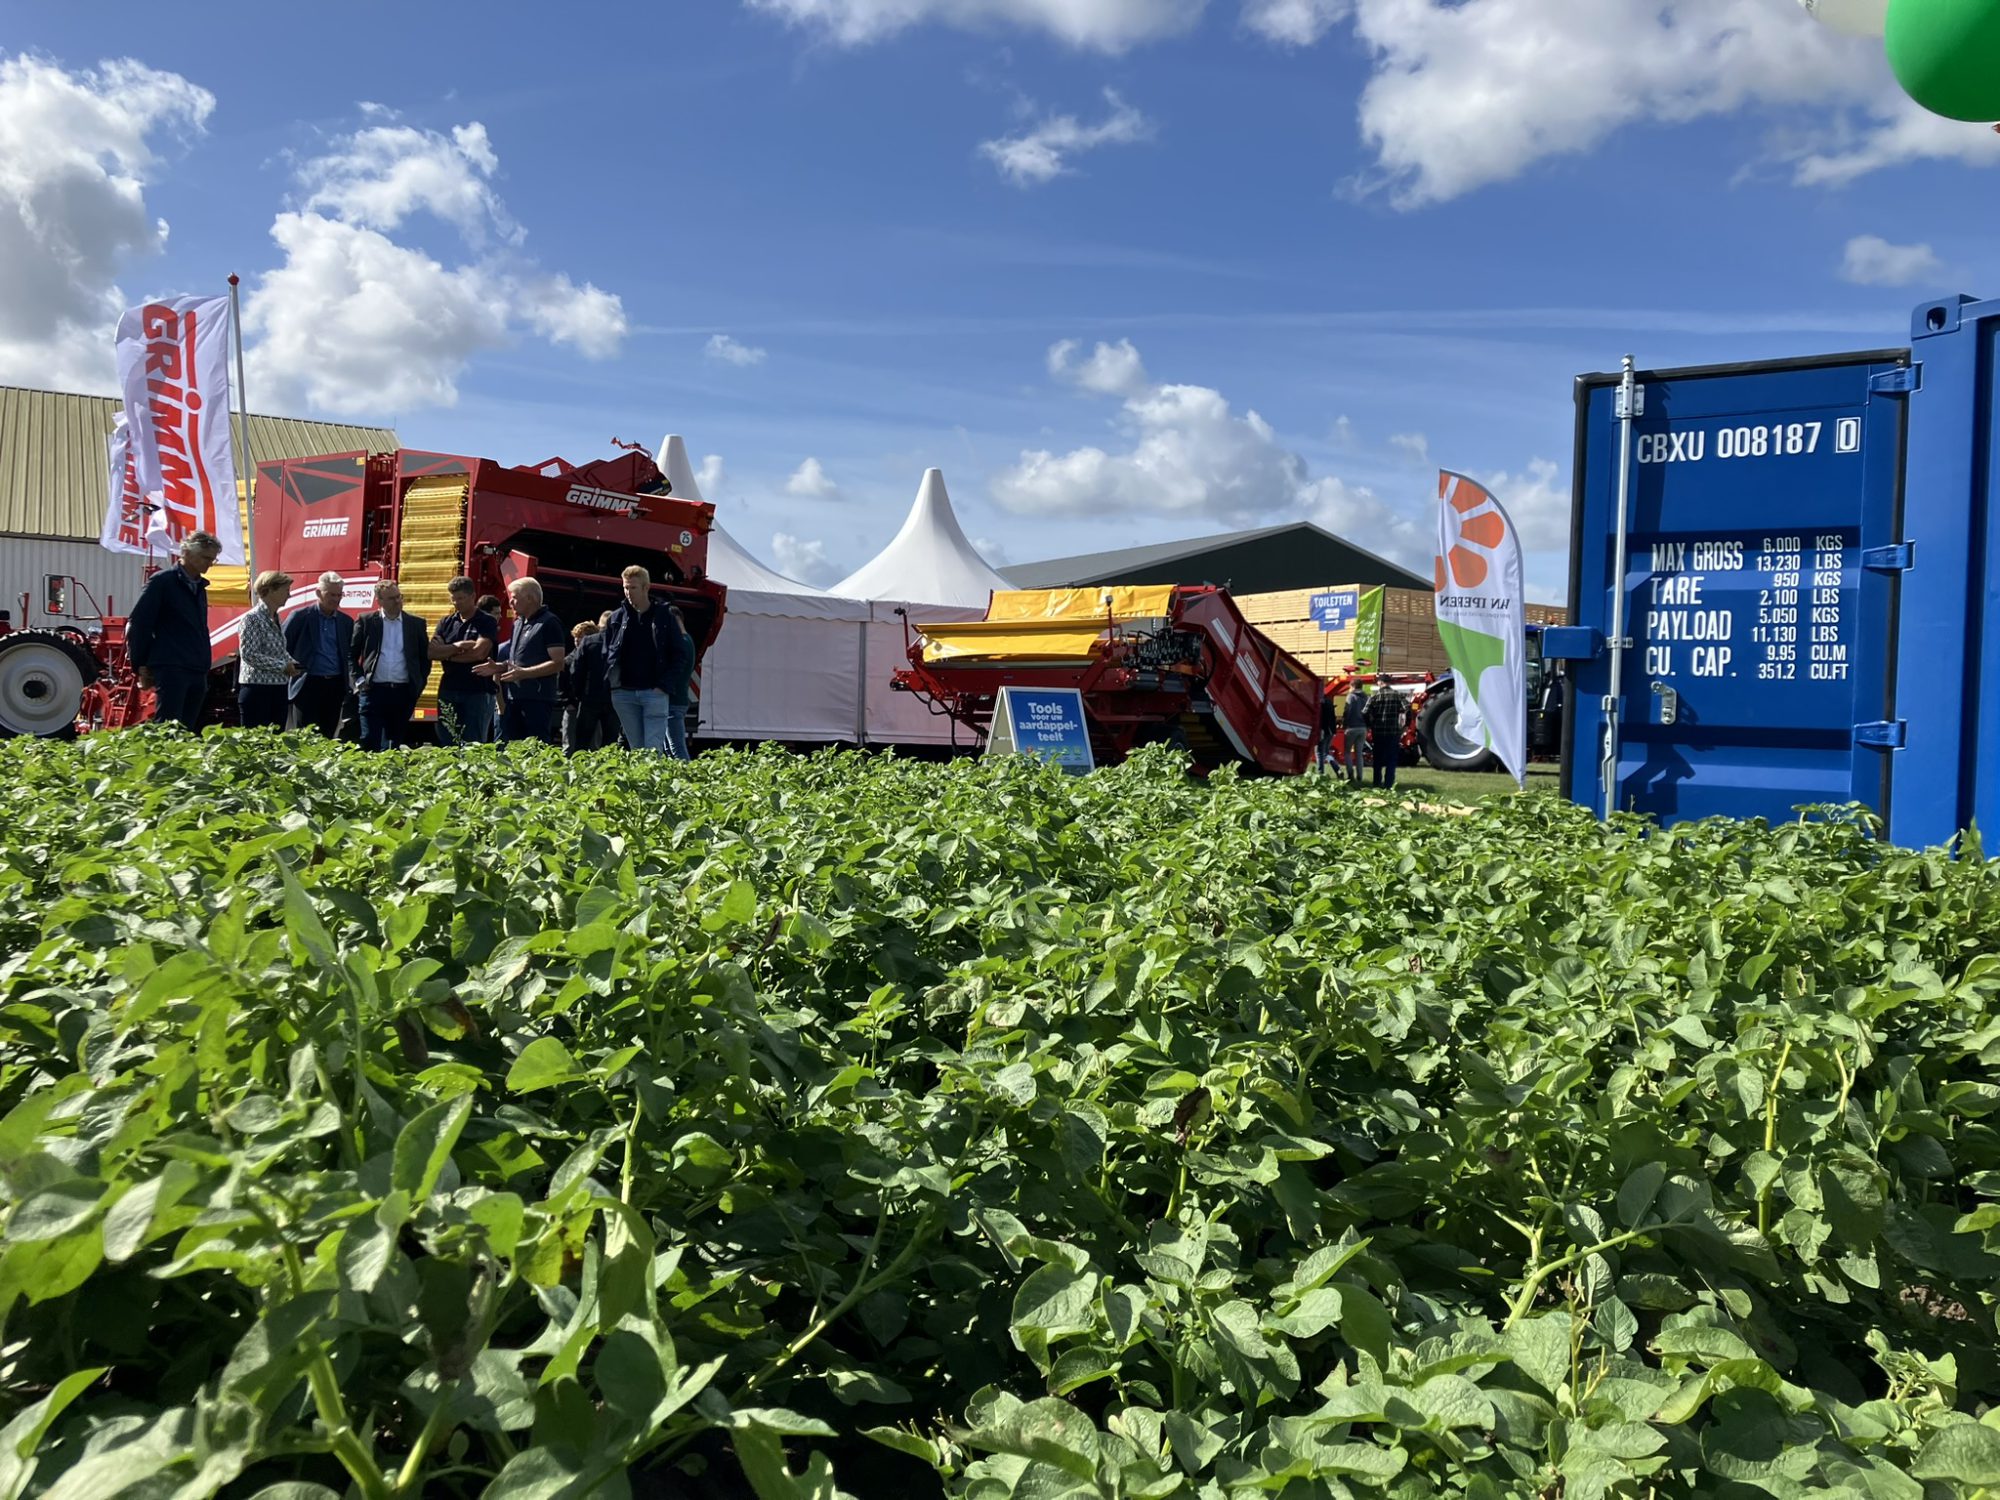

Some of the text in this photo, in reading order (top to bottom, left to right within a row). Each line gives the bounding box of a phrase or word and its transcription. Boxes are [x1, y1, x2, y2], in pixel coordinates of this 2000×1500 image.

[142, 304, 199, 545] GRIMME
[1637, 419, 1857, 463] CBXU 008187 0
[303, 518, 348, 538] GRIMME
[1763, 535, 1843, 553] 6,000 KGS
[1652, 541, 1744, 571] MAX GROSS
[1756, 554, 1842, 571] 13,230 LBS
[1773, 572, 1842, 587] 950 KGS
[342, 590, 372, 598] ARITRON
[1650, 576, 1705, 604] TARE
[1760, 588, 1839, 606] 2,100 LBS
[1314, 595, 1354, 608] TOILETTEN
[1759, 607, 1839, 624] 5,050 KGS
[1646, 610, 1732, 640] PAYLOAD
[1752, 626, 1838, 643] 11,130 LBS
[1645, 646, 1737, 677] CU. CAP.
[1767, 645, 1846, 661] 9.95 CU.M
[1758, 663, 1849, 680] 351.2 CU.FT
[1027, 702, 1063, 715] Tools
[1031, 713, 1049, 721] voor
[1019, 720, 1079, 732] aardappel-
[1037, 732, 1064, 742] teelt
